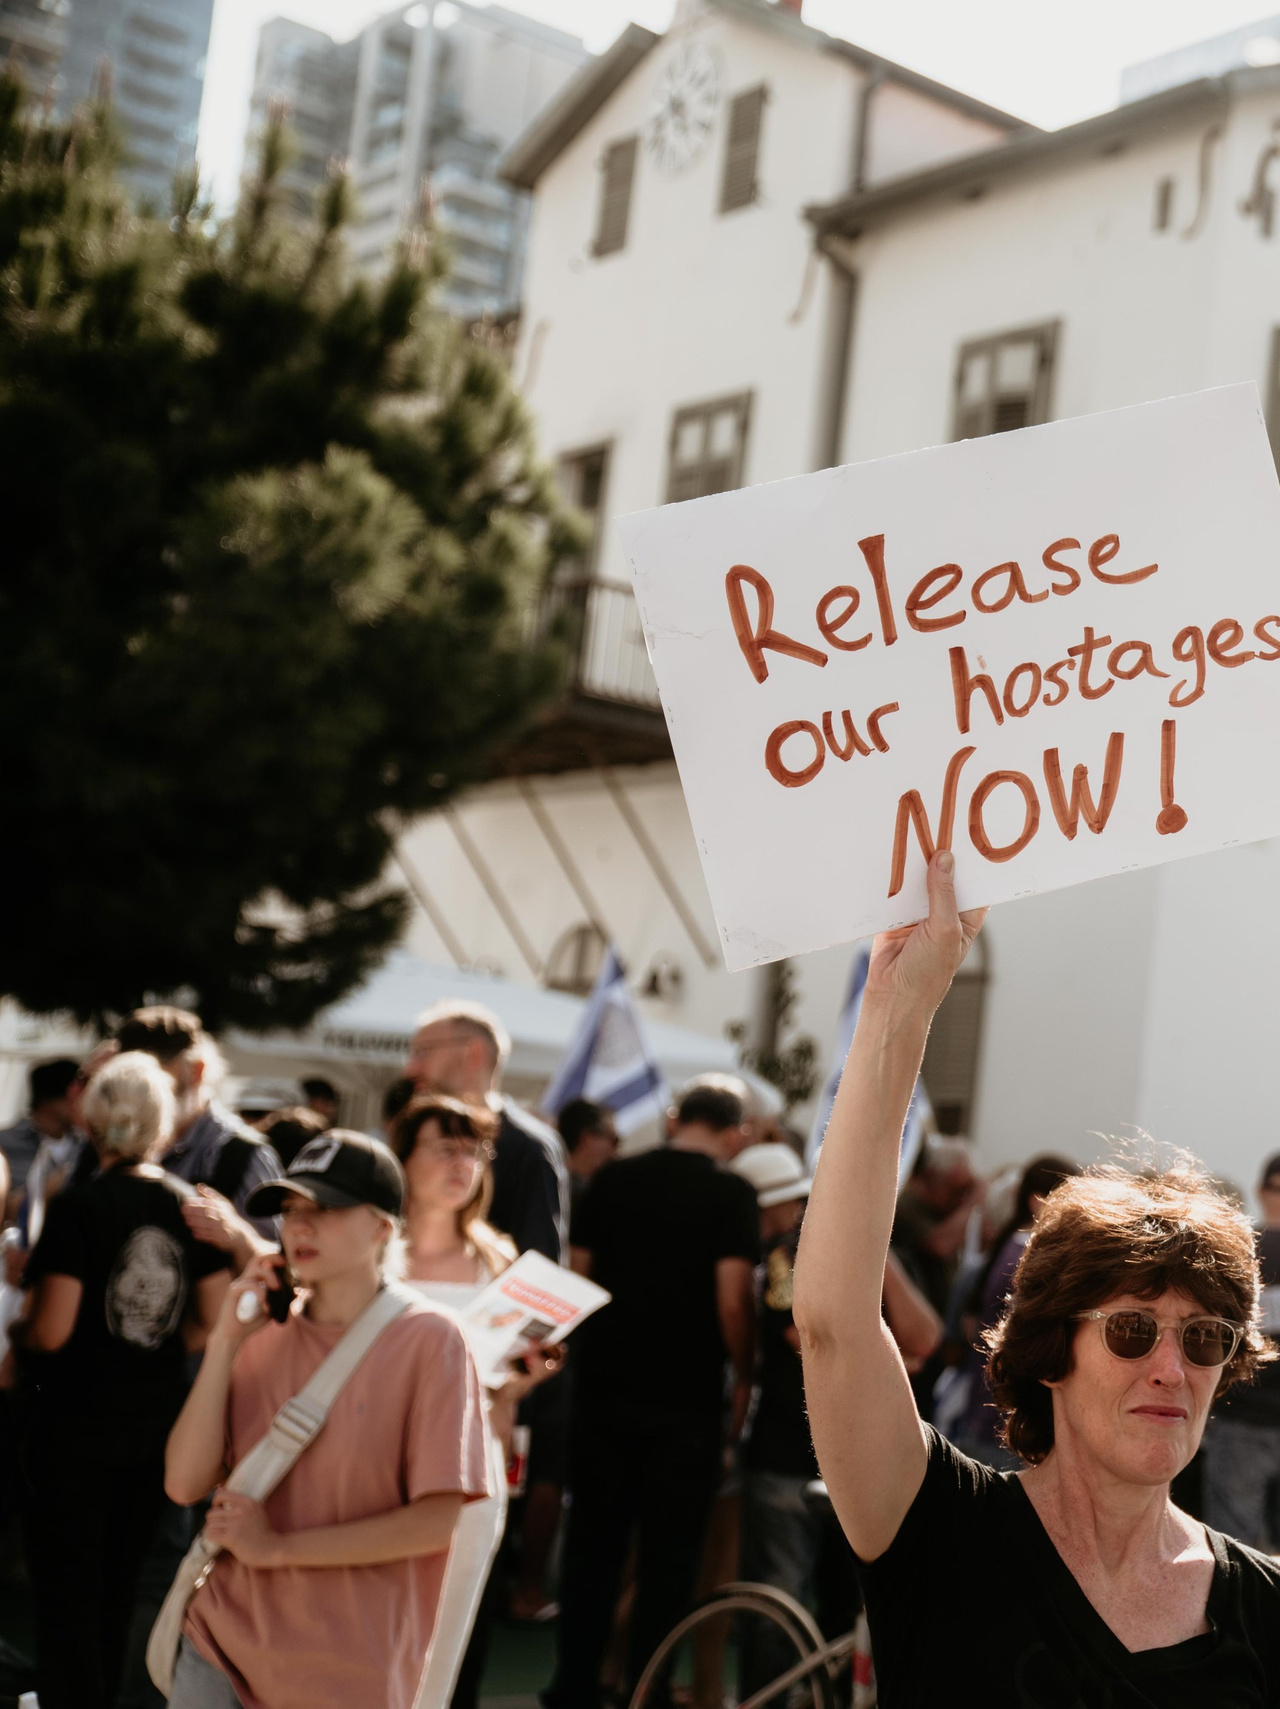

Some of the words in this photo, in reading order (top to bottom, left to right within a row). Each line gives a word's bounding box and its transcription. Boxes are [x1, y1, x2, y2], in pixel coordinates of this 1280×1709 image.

[725, 533, 1159, 684] Release
[765, 701, 900, 788] our
[887, 719, 1189, 898] NOW!
